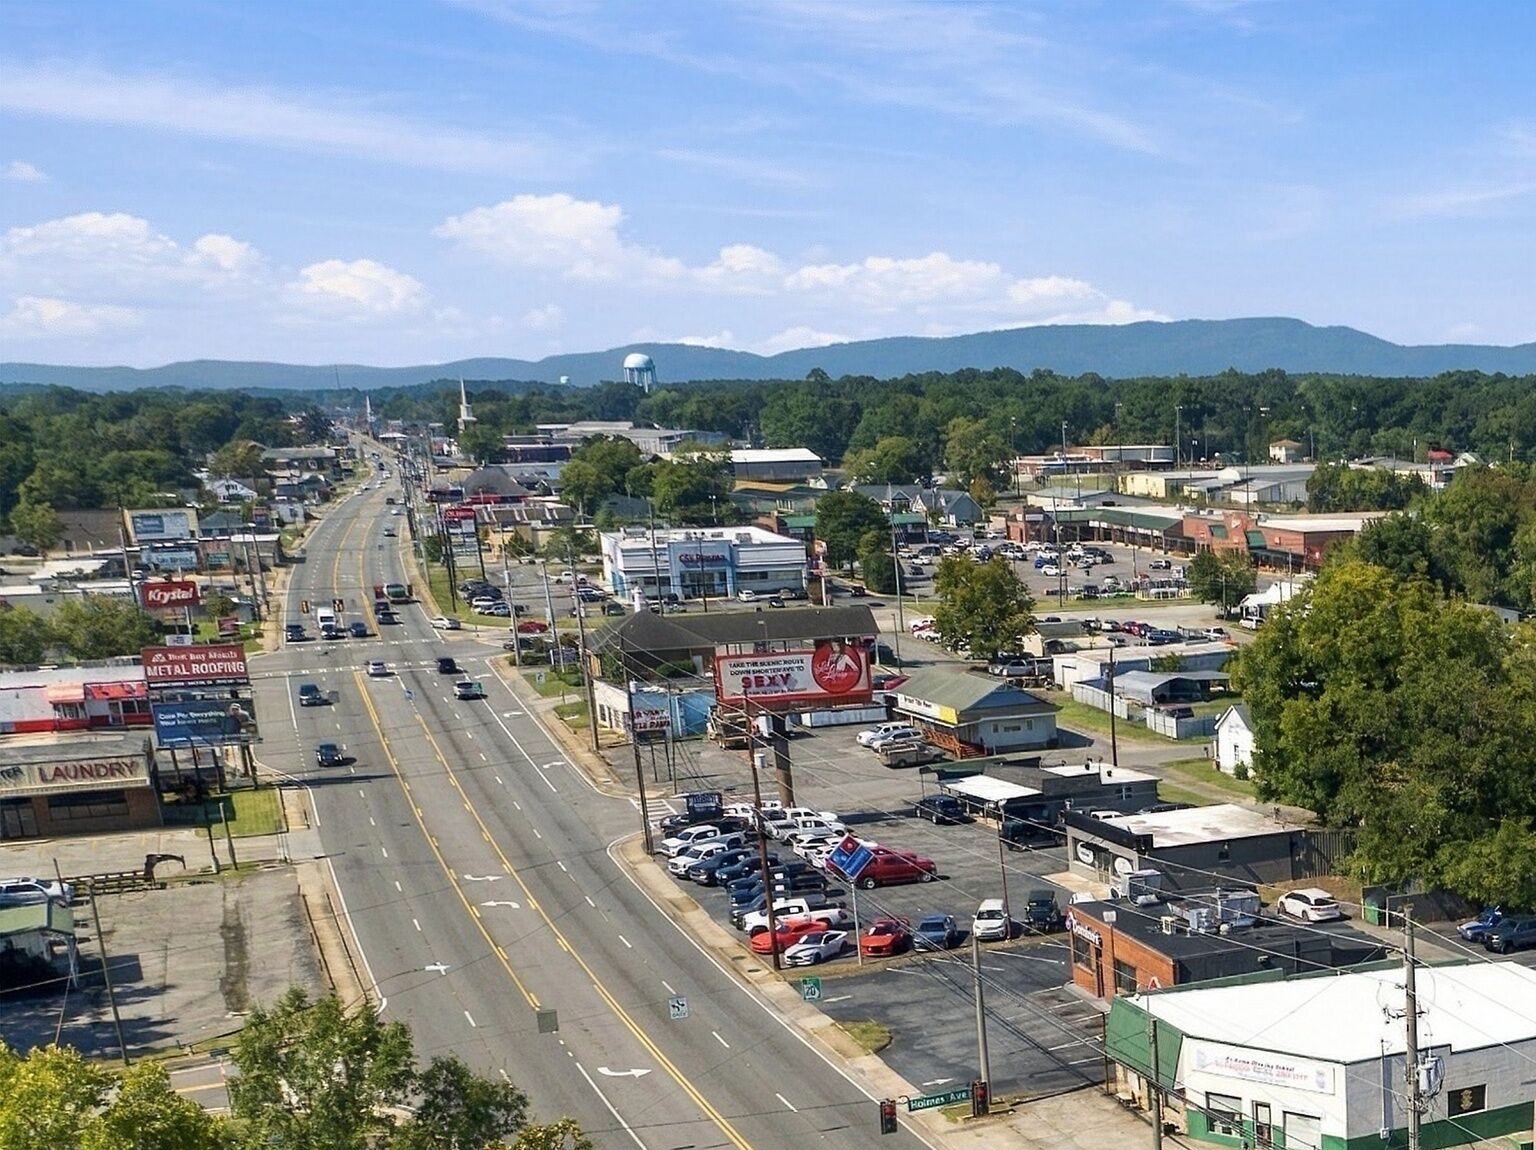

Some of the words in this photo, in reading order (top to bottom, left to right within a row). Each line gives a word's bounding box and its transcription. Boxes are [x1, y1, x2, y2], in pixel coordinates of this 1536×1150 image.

[147, 588, 194, 604] Krystal
[189, 652, 206, 662] Buy
[728, 661, 746, 669] TAKE
[783, 658, 805, 666] ROUTE
[146, 664, 190, 677] METAL
[191, 661, 246, 675] ROOFING
[730, 669, 751, 677] DOWN
[741, 673, 792, 689] SEXY
[37, 760, 140, 783] LAUNDRY
[910, 1097, 946, 1110] Holmes
[949, 1093, 967, 1102] Ave
